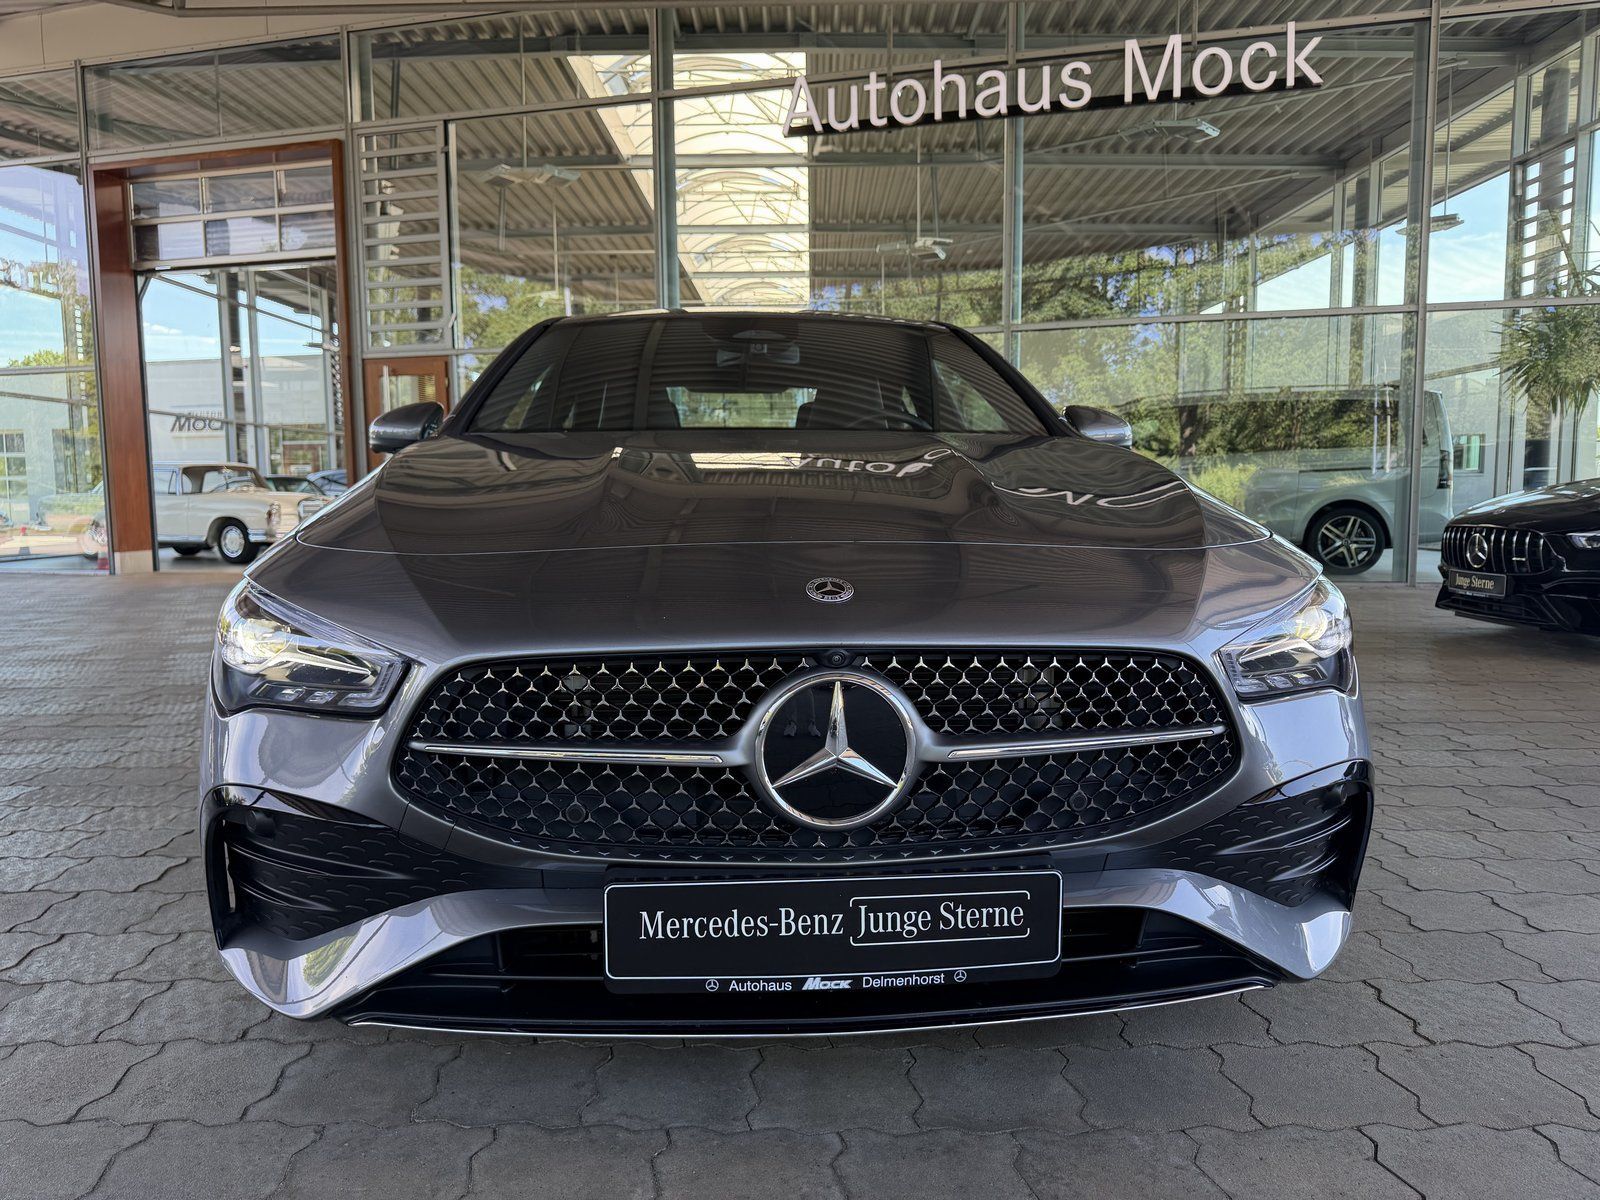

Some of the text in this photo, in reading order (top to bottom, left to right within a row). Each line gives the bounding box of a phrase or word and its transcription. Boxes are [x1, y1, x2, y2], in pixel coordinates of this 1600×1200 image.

[782, 21, 1324, 138] Autohaus Mock
[639, 901, 1024, 940] Mercedes-Benz Junge Sterne
[728, 979, 793, 992] Autohaus
[862, 972, 945, 989] Delmenhorst
